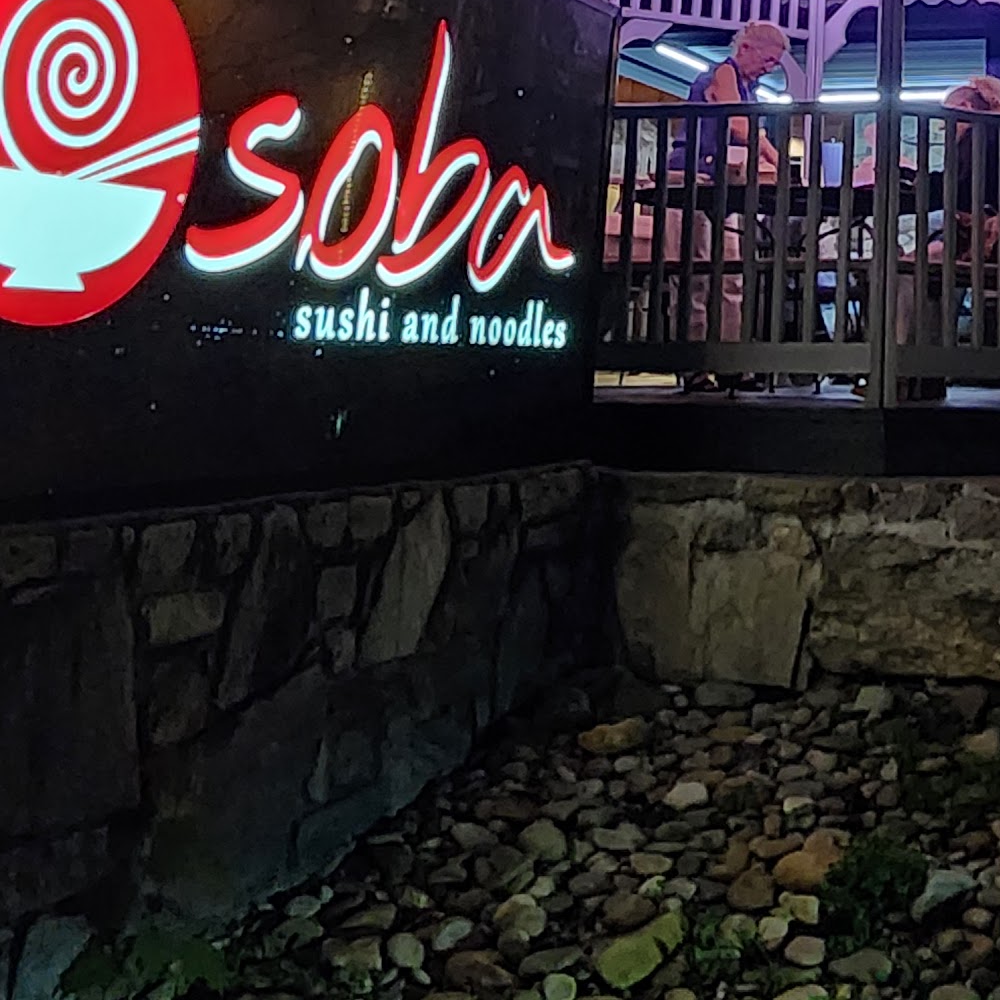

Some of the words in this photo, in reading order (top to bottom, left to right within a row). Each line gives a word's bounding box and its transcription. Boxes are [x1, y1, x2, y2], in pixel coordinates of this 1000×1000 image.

[185, 19, 577, 291] soba
[293, 288, 389, 343] sushi
[401, 295, 459, 345] and
[470, 300, 568, 349] noodles
